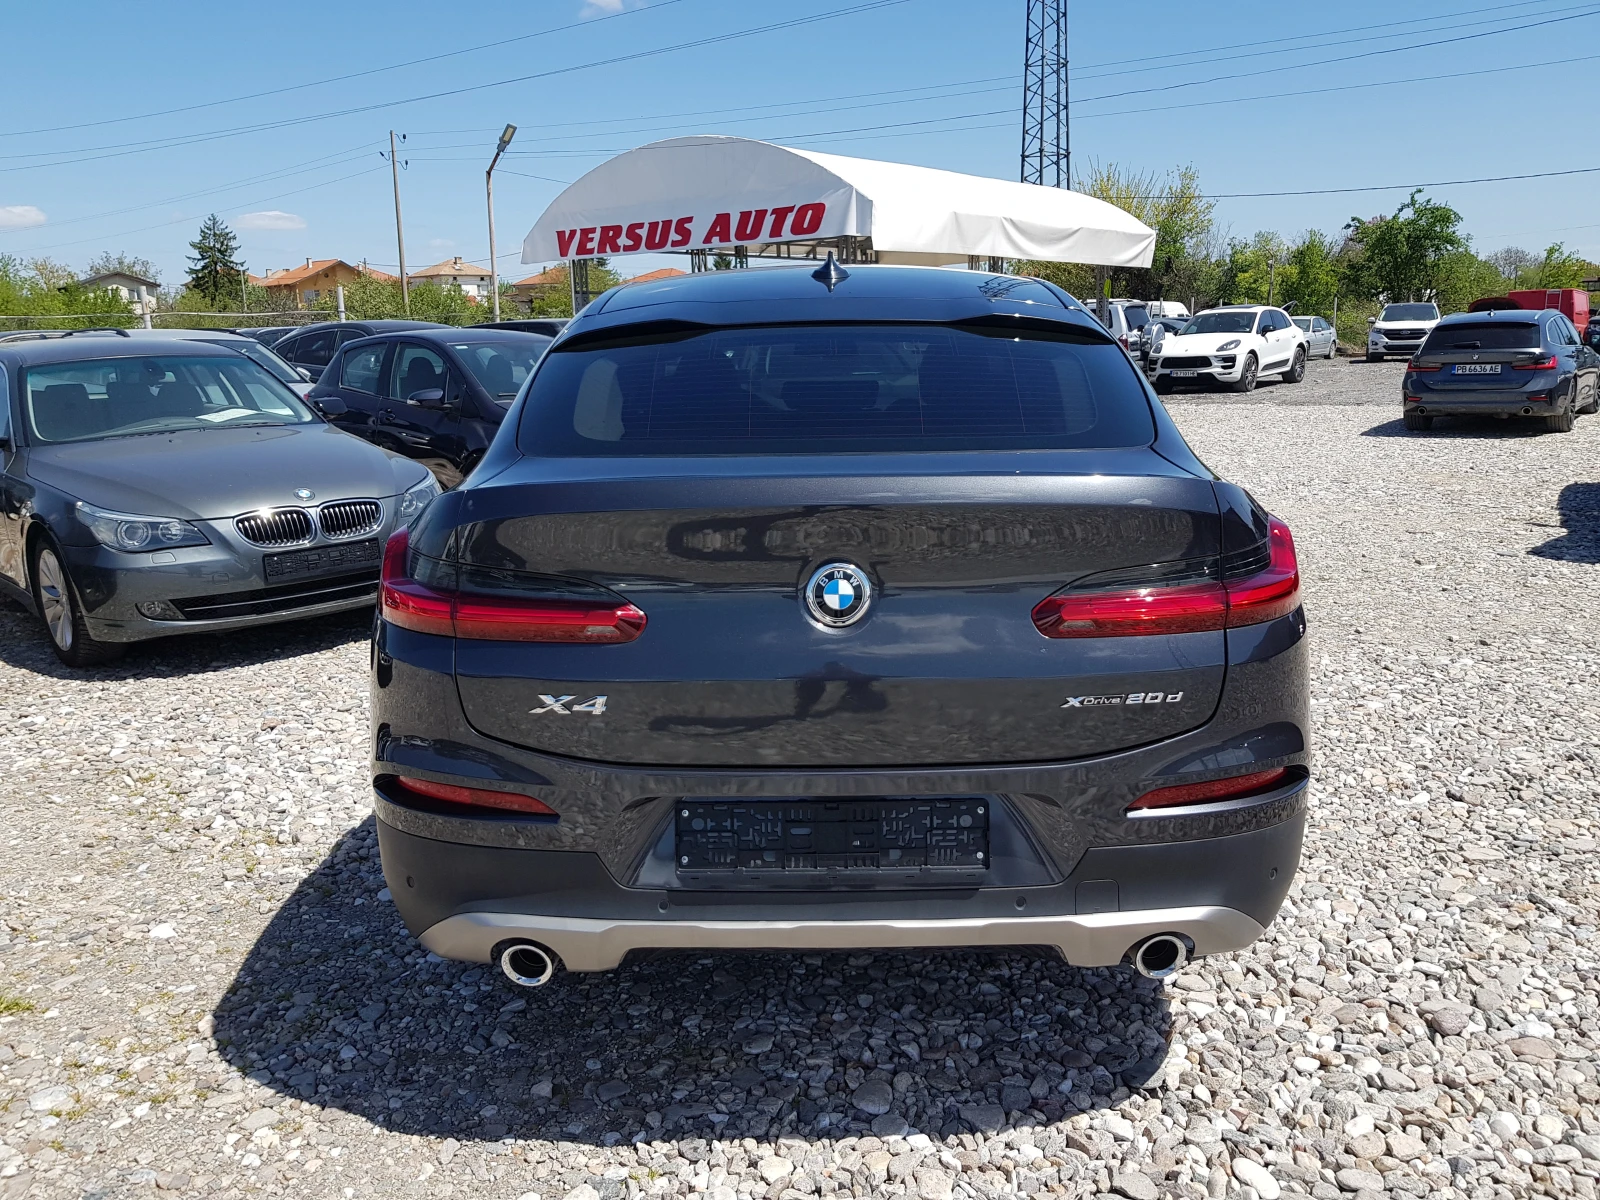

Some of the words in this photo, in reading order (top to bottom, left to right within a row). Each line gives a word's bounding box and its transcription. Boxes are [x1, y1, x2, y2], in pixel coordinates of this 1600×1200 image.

[555, 216, 694, 258] VERSUS
[702, 202, 826, 244] AUTO
[1456, 365, 1467, 373] PB
[1468, 365, 1488, 373] 6636
[1489, 365, 1500, 373] AE
[818, 570, 860, 587] BMW
[528, 694, 608, 714] X4
